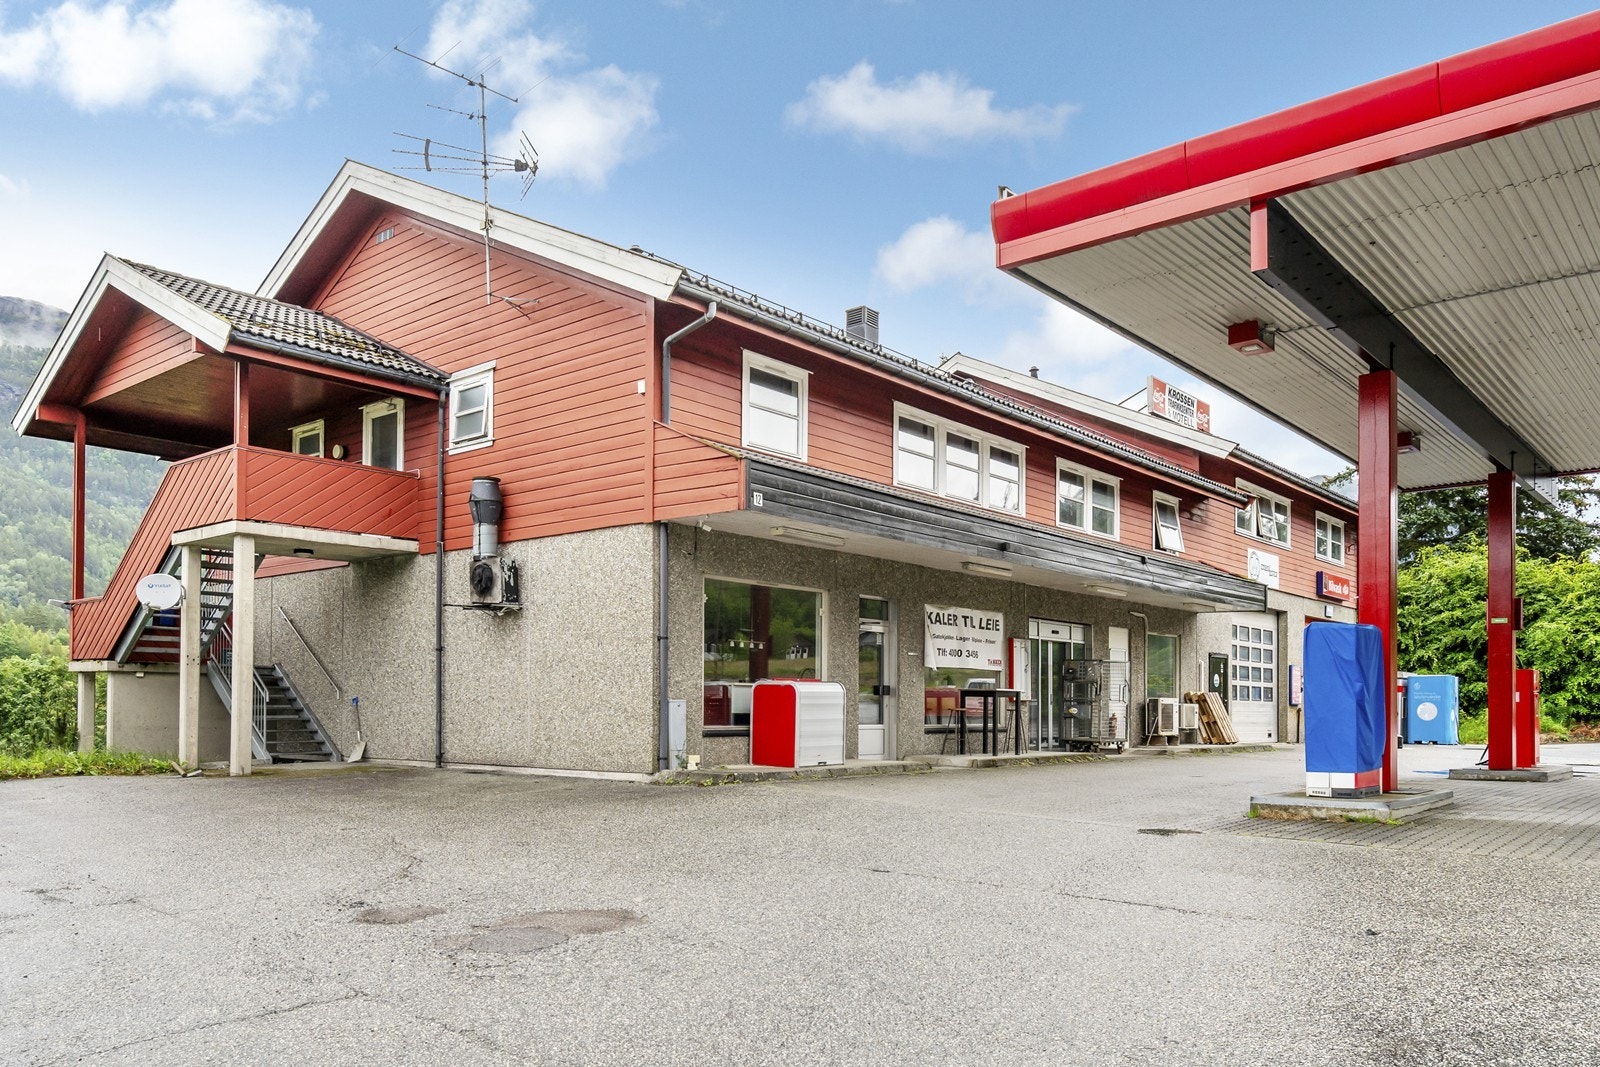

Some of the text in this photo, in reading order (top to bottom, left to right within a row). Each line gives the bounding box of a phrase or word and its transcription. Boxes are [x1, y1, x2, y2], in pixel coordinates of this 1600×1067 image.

[1167, 387, 1196, 409] KROSSEN
[1172, 410, 1195, 428] MOTELL
[978, 617, 1000, 632] LEIE
